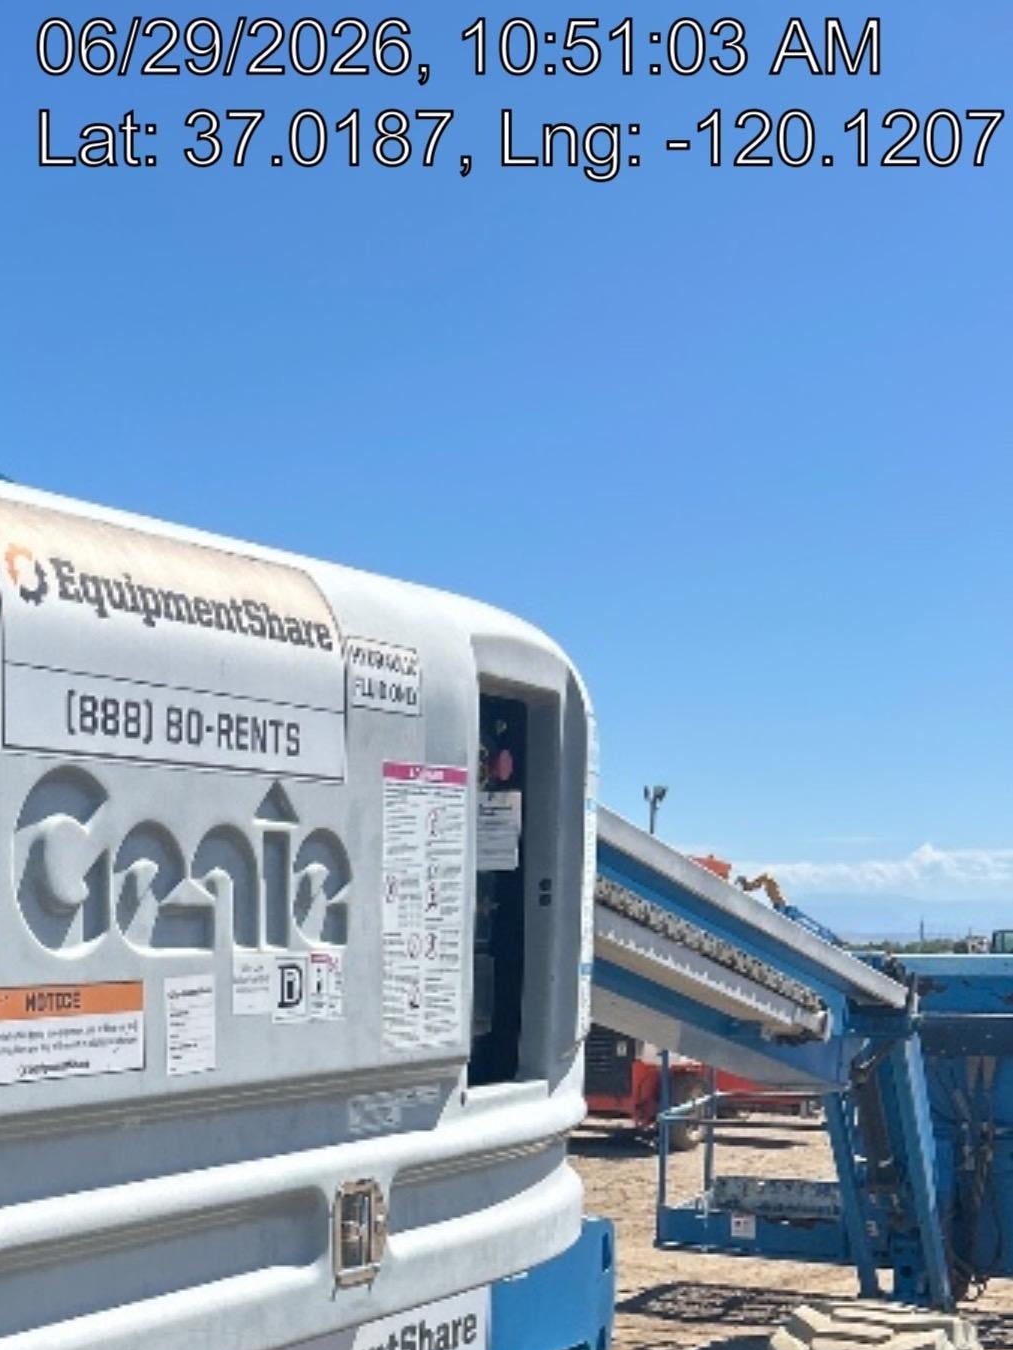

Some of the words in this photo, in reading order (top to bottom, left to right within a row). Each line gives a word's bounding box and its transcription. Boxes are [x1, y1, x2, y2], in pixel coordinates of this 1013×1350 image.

[48, 556, 334, 652] EquipmentShare
[67, 688, 153, 745] (888)
[166, 704, 301, 757] 80-RENTS
[12, 763, 354, 960] Genie
[25, 990, 82, 1013] NOTICE
